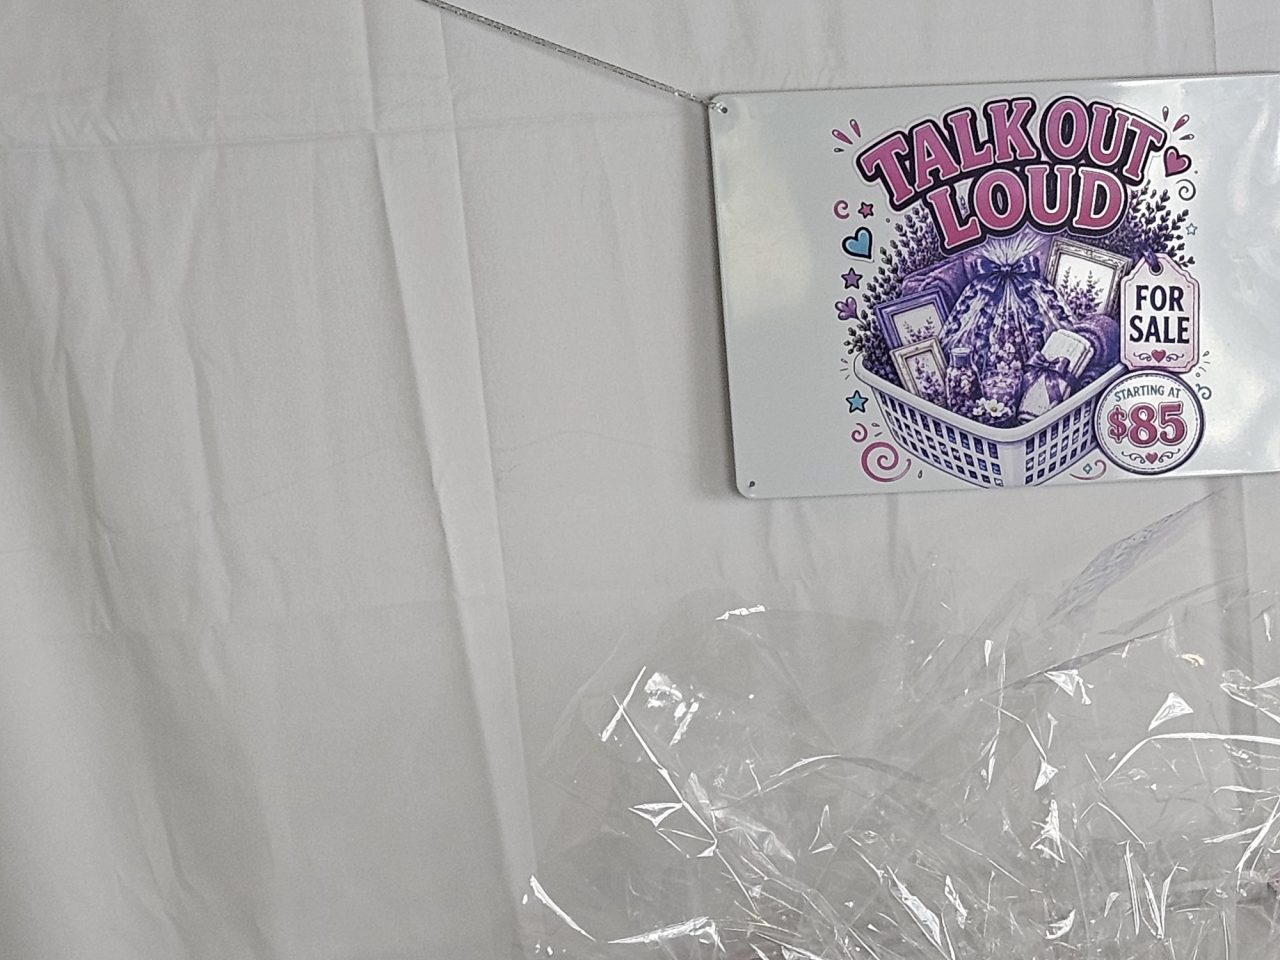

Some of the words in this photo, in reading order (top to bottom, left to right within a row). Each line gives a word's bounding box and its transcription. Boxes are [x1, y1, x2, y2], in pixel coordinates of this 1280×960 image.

[860, 101, 1037, 203] TALK
[1046, 98, 1166, 181] OUT
[927, 165, 1124, 248] LOUD
[1135, 284, 1185, 312] FOR
[1129, 315, 1190, 344] SALE
[1114, 384, 1165, 402] STARTING
[1168, 386, 1182, 399] AT
[1107, 401, 1187, 448] $85
